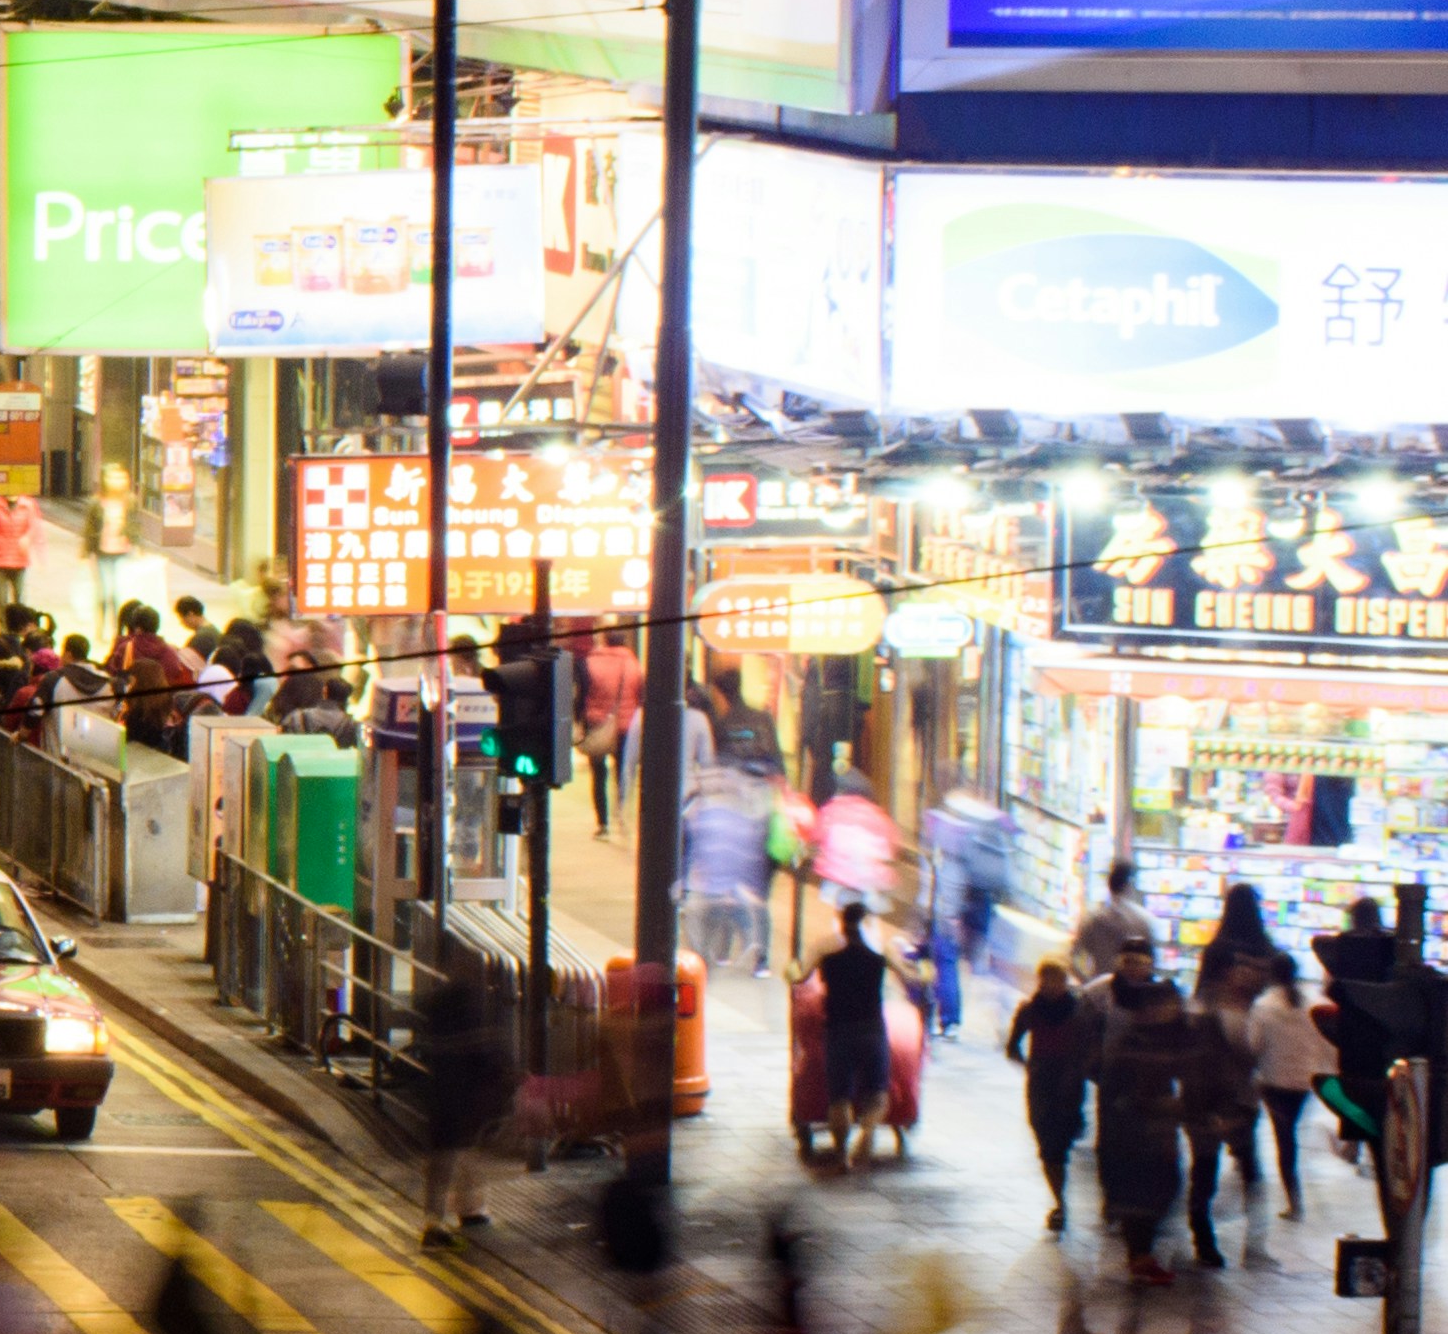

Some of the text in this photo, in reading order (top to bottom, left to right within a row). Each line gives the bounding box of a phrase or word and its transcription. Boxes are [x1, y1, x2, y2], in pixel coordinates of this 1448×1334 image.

[997, 272, 1222, 339] Cetaphil
[373, 506, 420, 526] Sun
[1111, 586, 1175, 626] SUN
[1195, 591, 1316, 634] CHEUNG
